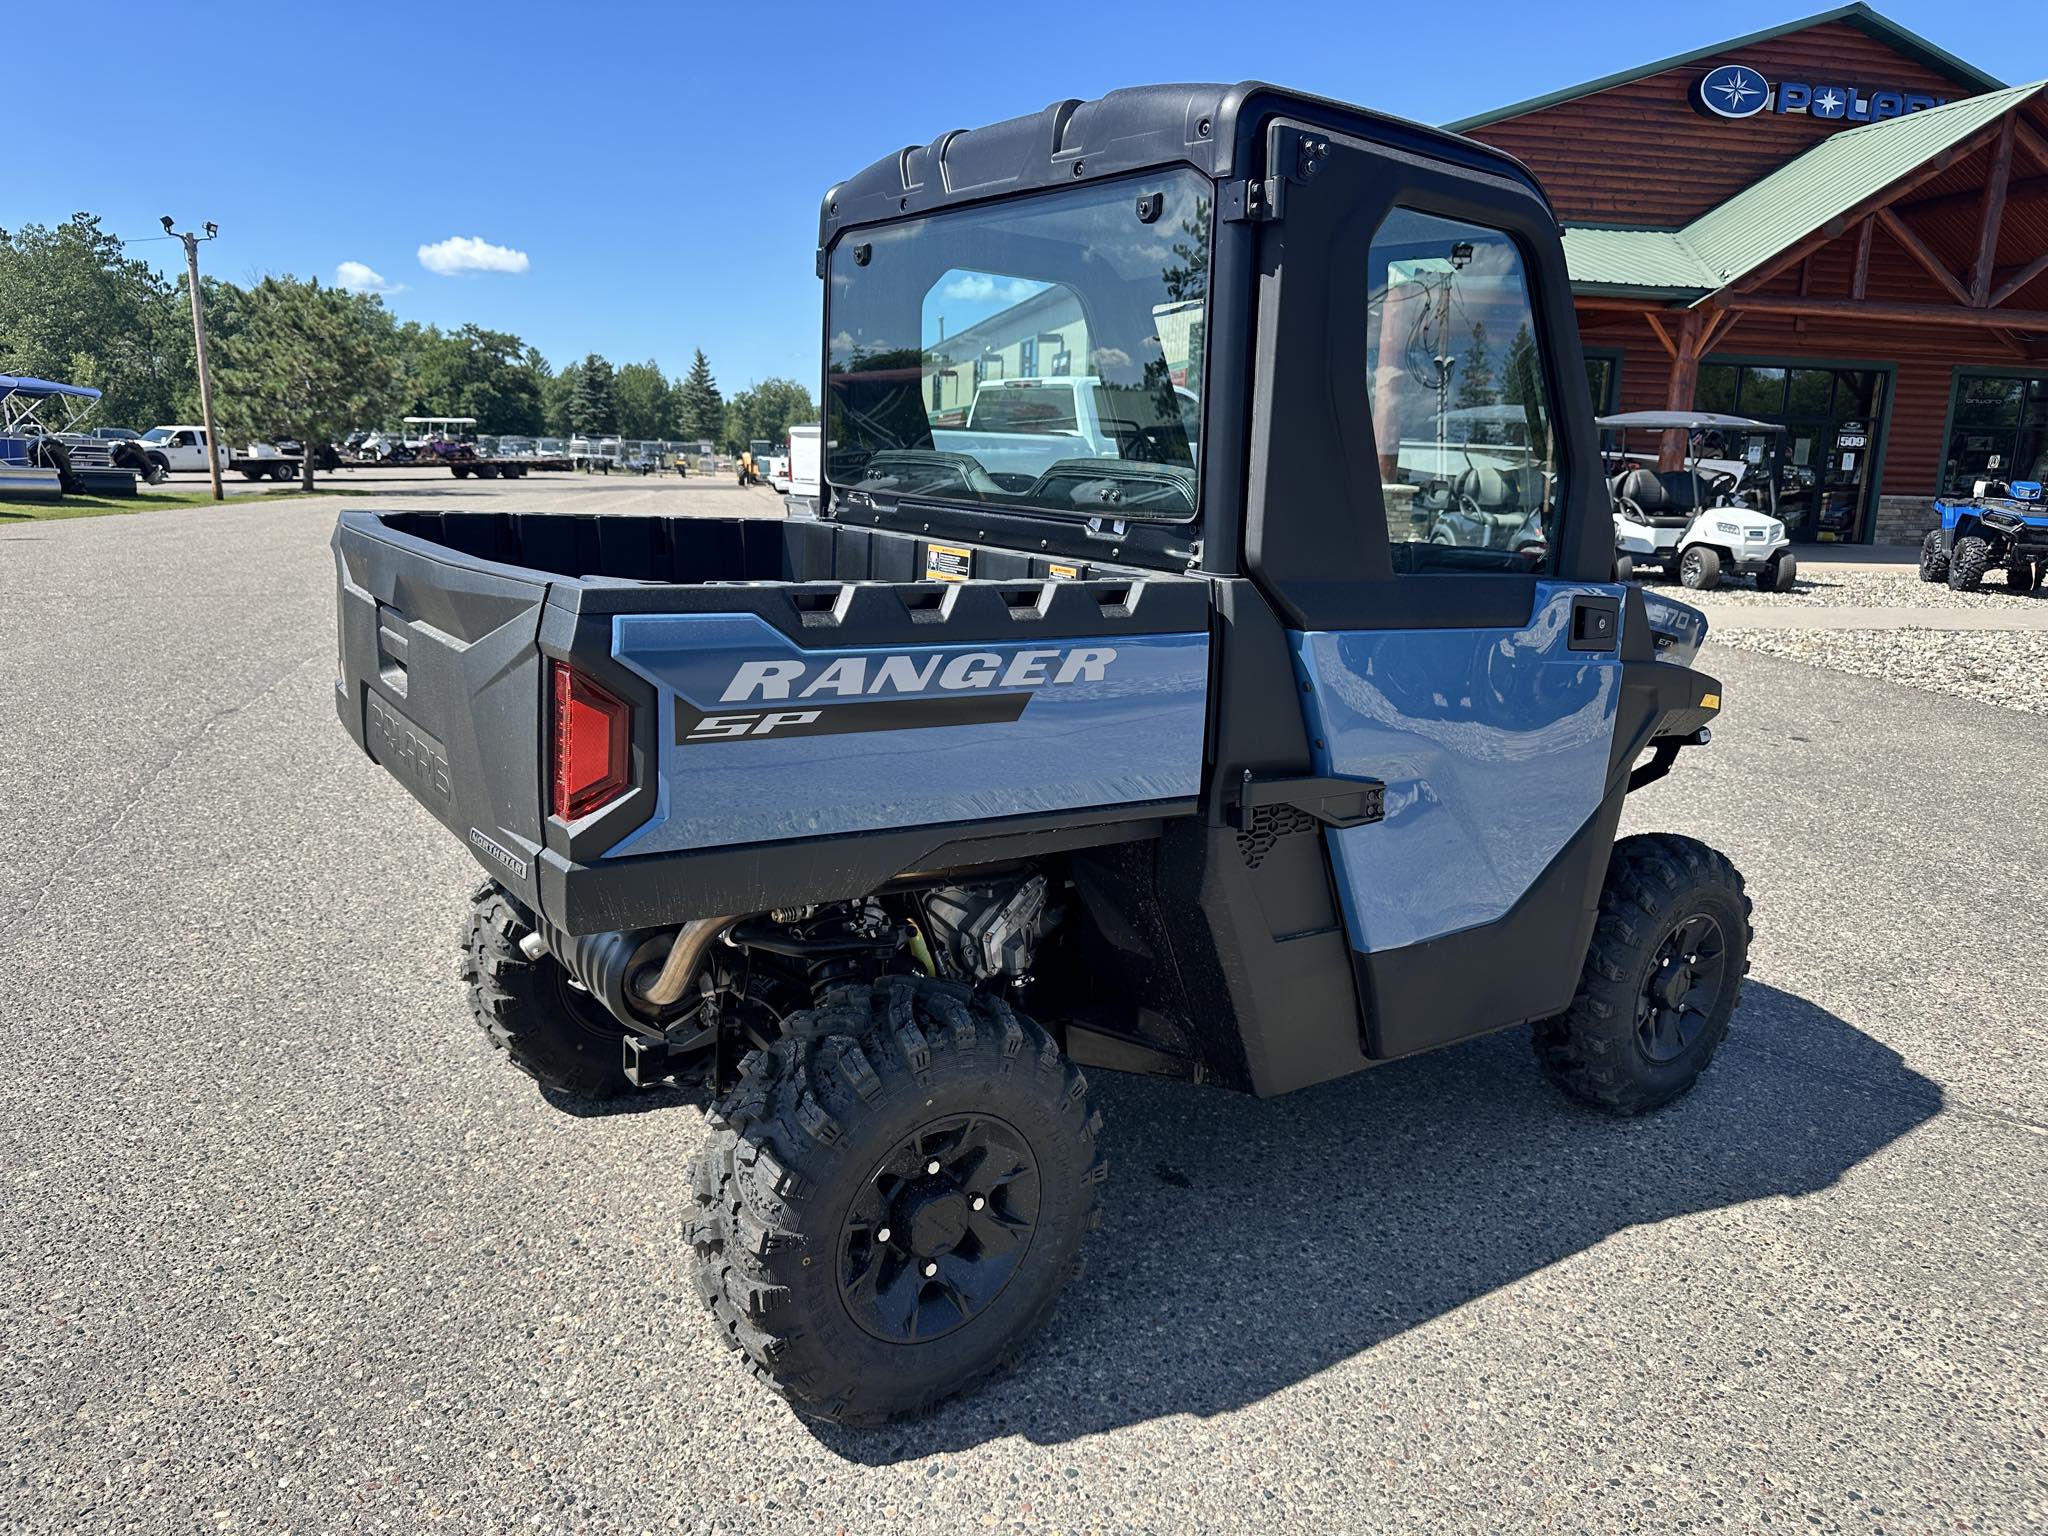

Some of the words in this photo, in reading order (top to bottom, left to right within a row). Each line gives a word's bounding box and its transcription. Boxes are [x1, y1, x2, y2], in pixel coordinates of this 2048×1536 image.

[1776, 82, 1950, 123] POLAR
[1840, 436, 1865, 447] 509
[1651, 604, 1690, 630] 570
[1658, 639, 1674, 648] EFI
[719, 648, 1118, 702] RANGER
[686, 710, 823, 740] SP
[370, 703, 451, 803] POLARIS
[471, 831, 523, 874] NORTHSTAR
